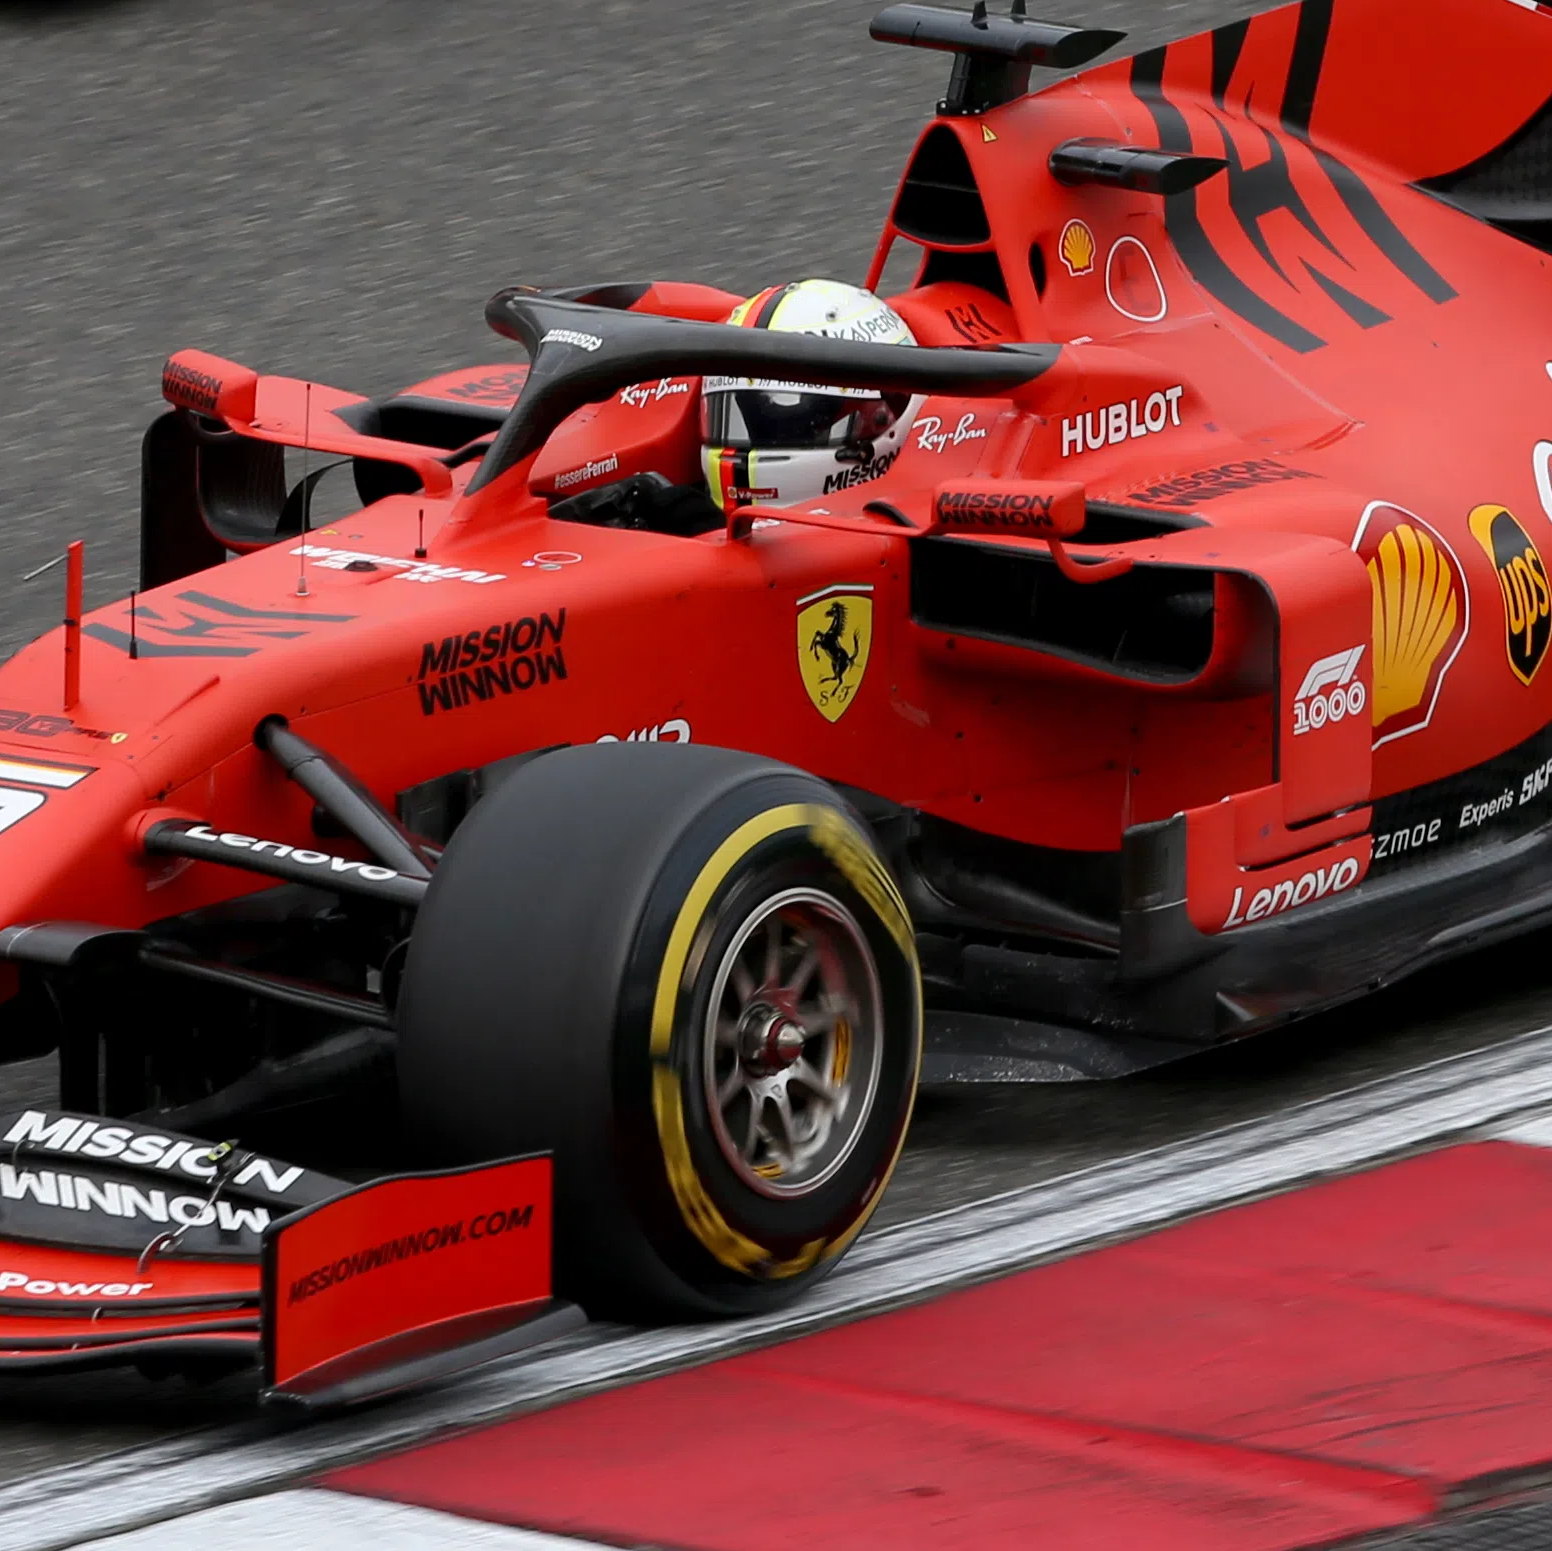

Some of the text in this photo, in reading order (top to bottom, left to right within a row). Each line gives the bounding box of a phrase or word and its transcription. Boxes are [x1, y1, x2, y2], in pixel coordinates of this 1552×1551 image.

[912, 413, 988, 454] Ray-Ban
[1060, 385, 1184, 458] HUBLOT
[553, 452, 619, 490] #essereFerrari
[1128, 458, 1286, 505] MISSION
[937, 491, 1056, 511] MISSION
[937, 509, 1056, 528] WINNOW
[1499, 547, 1550, 658] ups
[417, 606, 568, 682] MISSION
[417, 648, 569, 718] WINNOW
[1293, 681, 1366, 736] 1000
[1459, 789, 1513, 829] Experis
[184, 825, 399, 883] Lenovo
[1222, 856, 1360, 931] Lenovo
[286, 1204, 534, 1309] MISSIONWINNOW.COM
